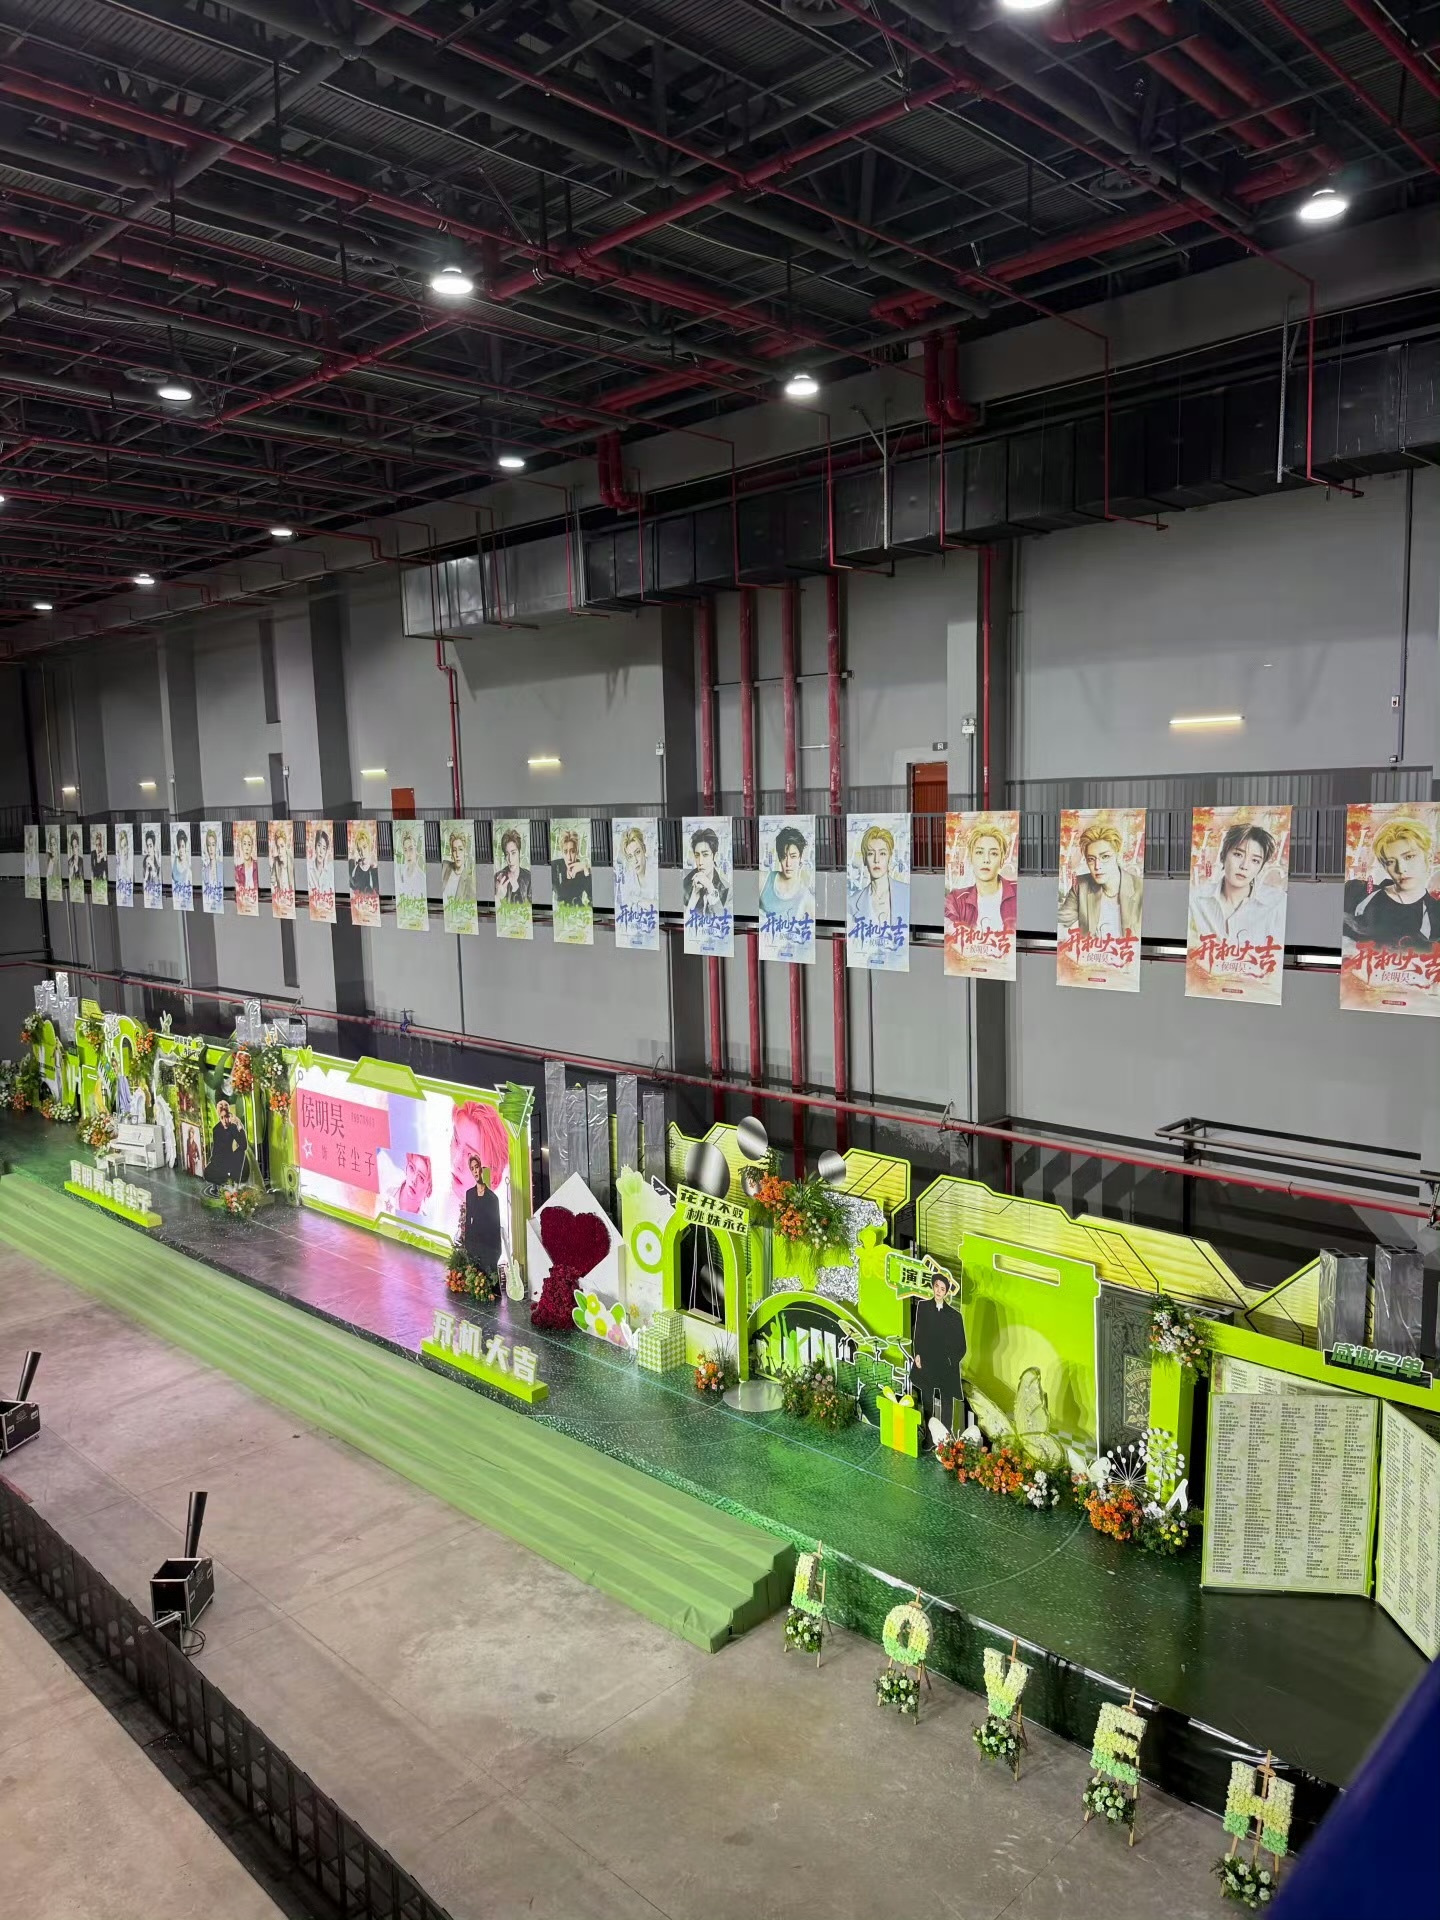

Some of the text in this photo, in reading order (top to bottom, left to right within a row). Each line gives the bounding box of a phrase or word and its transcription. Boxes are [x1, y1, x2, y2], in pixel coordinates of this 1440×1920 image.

[760, 912, 814, 945] 开机大吉
[848, 917, 908, 951] 开机大吉
[946, 921, 1014, 959] 开机大吉
[1058, 928, 1139, 969] 开机大吉
[1189, 934, 1282, 979] 开机大吉
[301, 1093, 345, 1139] 侯明昊
[336, 1142, 375, 1177] 容尘子
[681, 1188, 744, 1220] 花开不败
[686, 1207, 748, 1234] 桃妹永在
[901, 1267, 933, 1290] 演员
[433, 1309, 538, 1386] 开机大吉
[1331, 1342, 1424, 1379] 感谢名单
